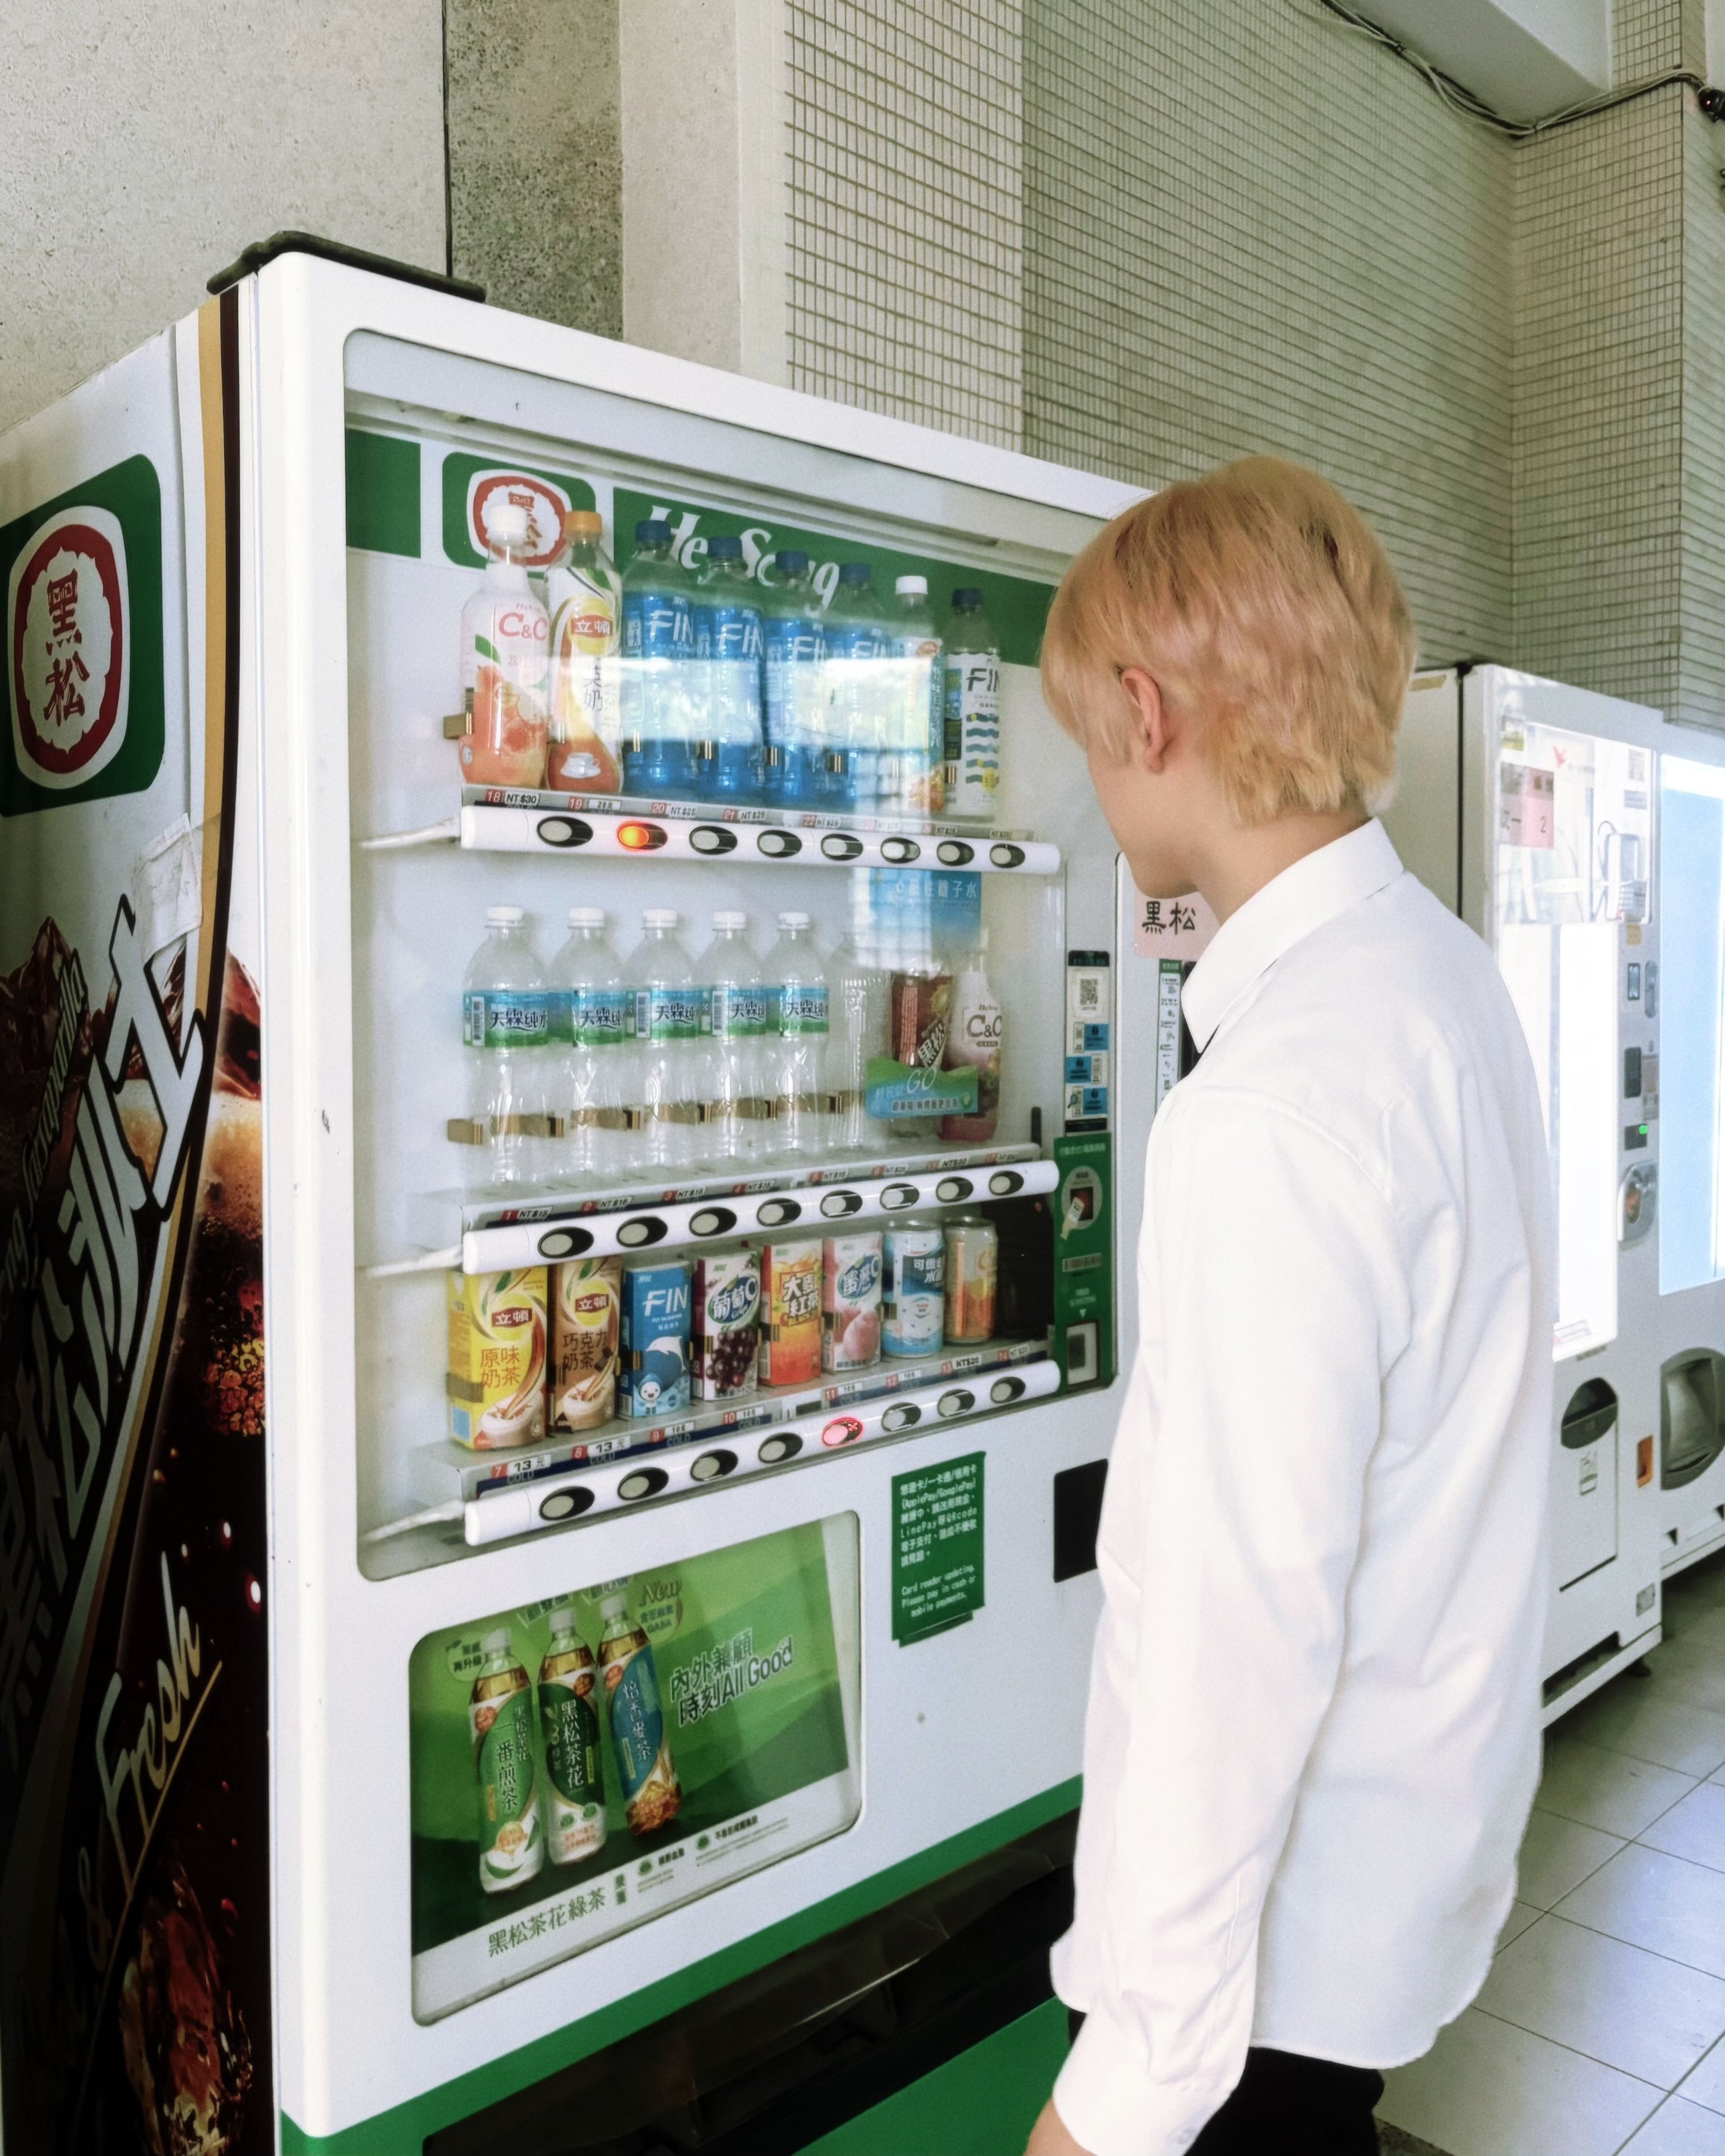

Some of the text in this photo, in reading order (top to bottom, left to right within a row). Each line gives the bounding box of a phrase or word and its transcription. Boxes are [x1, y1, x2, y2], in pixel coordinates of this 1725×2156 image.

[499, 613, 548, 641] C&C
[575, 620, 611, 635] 立頓
[44, 568, 90, 727] 黑松
[487, 791, 501, 802] 18
[570, 799, 583, 809] 19
[652, 803, 666, 814] 20
[724, 810, 735, 819] 21
[804, 816, 815, 826] 22
[1142, 900, 1196, 935] 黑松
[967, 1015, 1002, 1038] C&C
[578, 1295, 607, 1310] 立頓
[642, 1285, 688, 1316] FIN
[495, 1310, 529, 1325] 立頓
[563, 1332, 607, 1352] 巧克力
[480, 1345, 520, 1368] 原味
[563, 1351, 594, 1370] 奶茶
[480, 1366, 520, 1388] 奶茶
[724, 1413, 735, 1424] 10
[575, 1448, 582, 1457] 8
[596, 1442, 612, 1453] 13
[495, 1467, 501, 1477] 7
[515, 1461, 531, 1472] 13
[748, 1636, 792, 1687] Good
[561, 1700, 584, 1788] 黑松茶花
[488, 1887, 606, 1957] 黑松茶花綠茶
